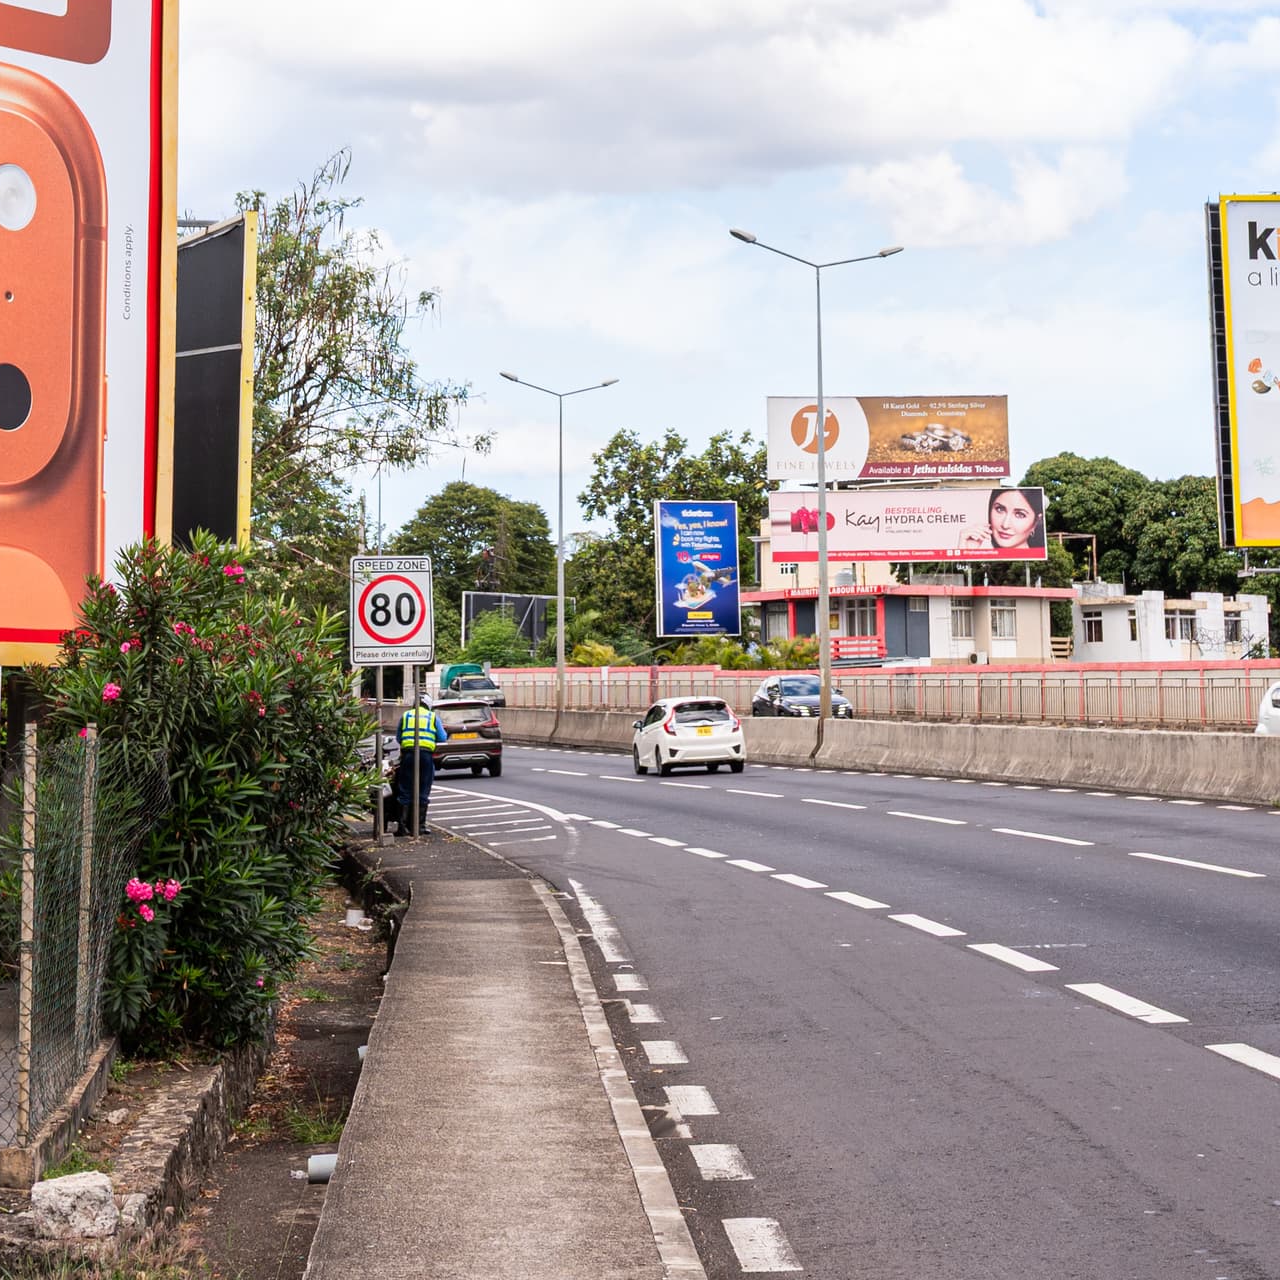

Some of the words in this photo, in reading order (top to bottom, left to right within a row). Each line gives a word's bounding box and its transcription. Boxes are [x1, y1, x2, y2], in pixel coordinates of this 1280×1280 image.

[124, 223, 134, 257] apply.
[1248, 272, 1262, 287] a
[122, 259, 132, 320] Conditions
[776, 461, 805, 471] FINE
[811, 460, 857, 471] JWELS
[868, 466, 902, 474] Available
[903, 466, 912, 474] at
[912, 464, 937, 475] Jetha
[938, 463, 973, 474] tulsidas
[974, 464, 1005, 473] Tribeca
[884, 506, 942, 514] BESTSELLING
[845, 508, 880, 533] Kay
[884, 515, 925, 525] HYDRA
[358, 561, 393, 570] SPEED
[397, 560, 427, 570] ZONE
[856, 585, 878, 593] PARTY
[370, 592, 416, 627] 80
[356, 650, 380, 659] Please
[381, 650, 399, 658] drive
[400, 649, 430, 660] carefully
